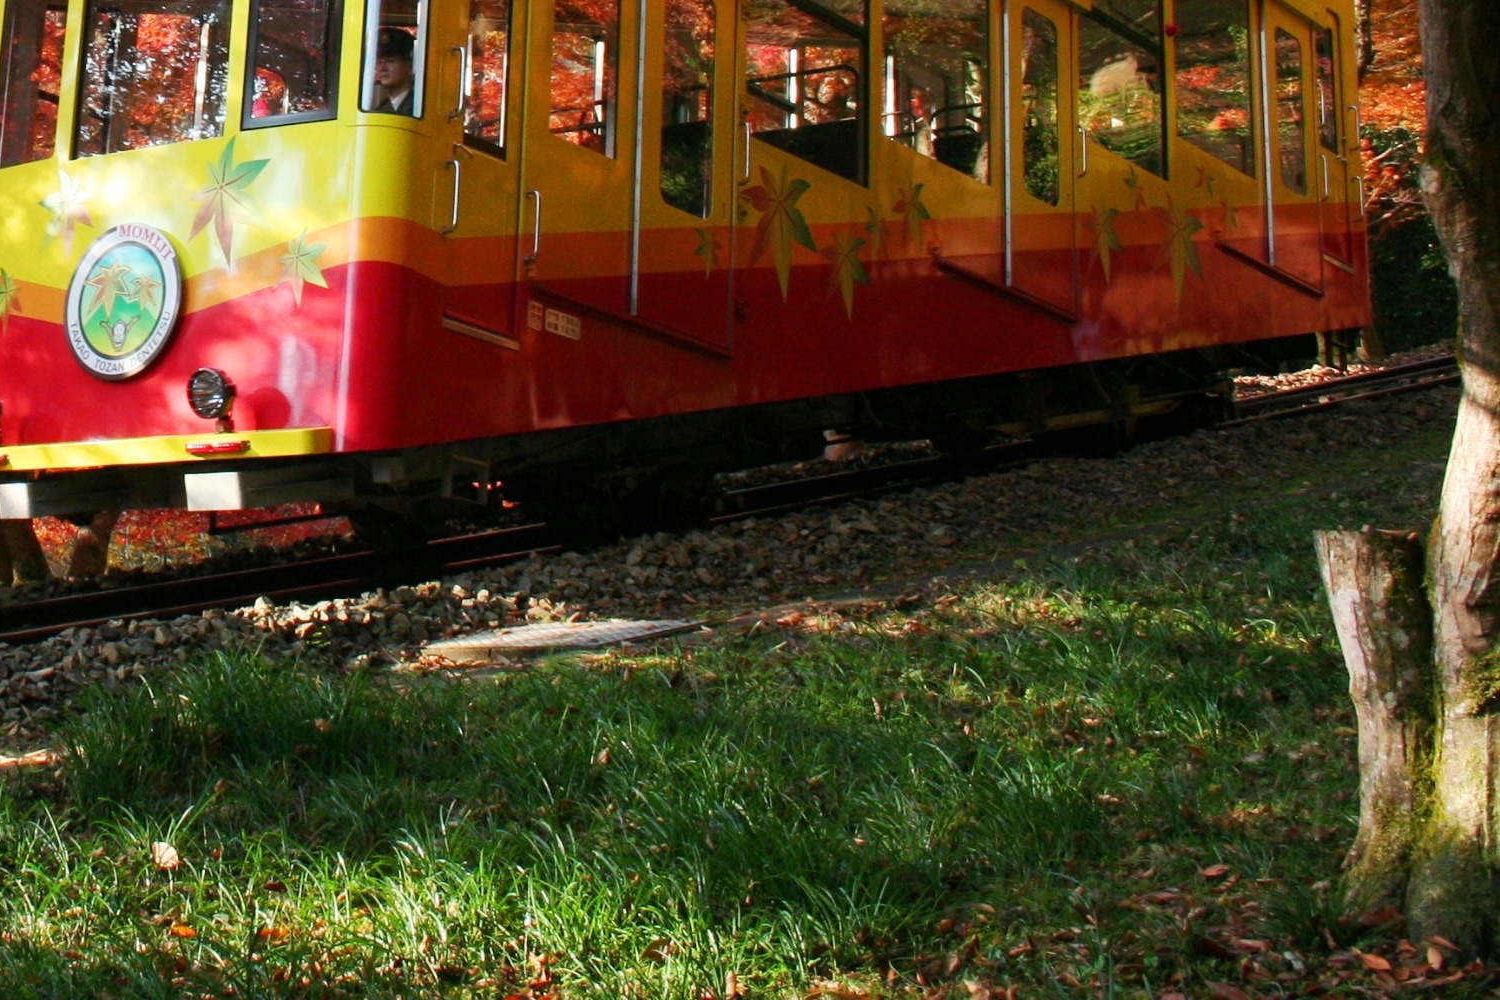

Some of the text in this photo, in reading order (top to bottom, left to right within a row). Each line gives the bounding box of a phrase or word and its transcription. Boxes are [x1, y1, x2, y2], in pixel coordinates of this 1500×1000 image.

[119, 224, 173, 260] MOMIJI
[70, 311, 171, 373] TAKAO TOZAN DENTETSU
